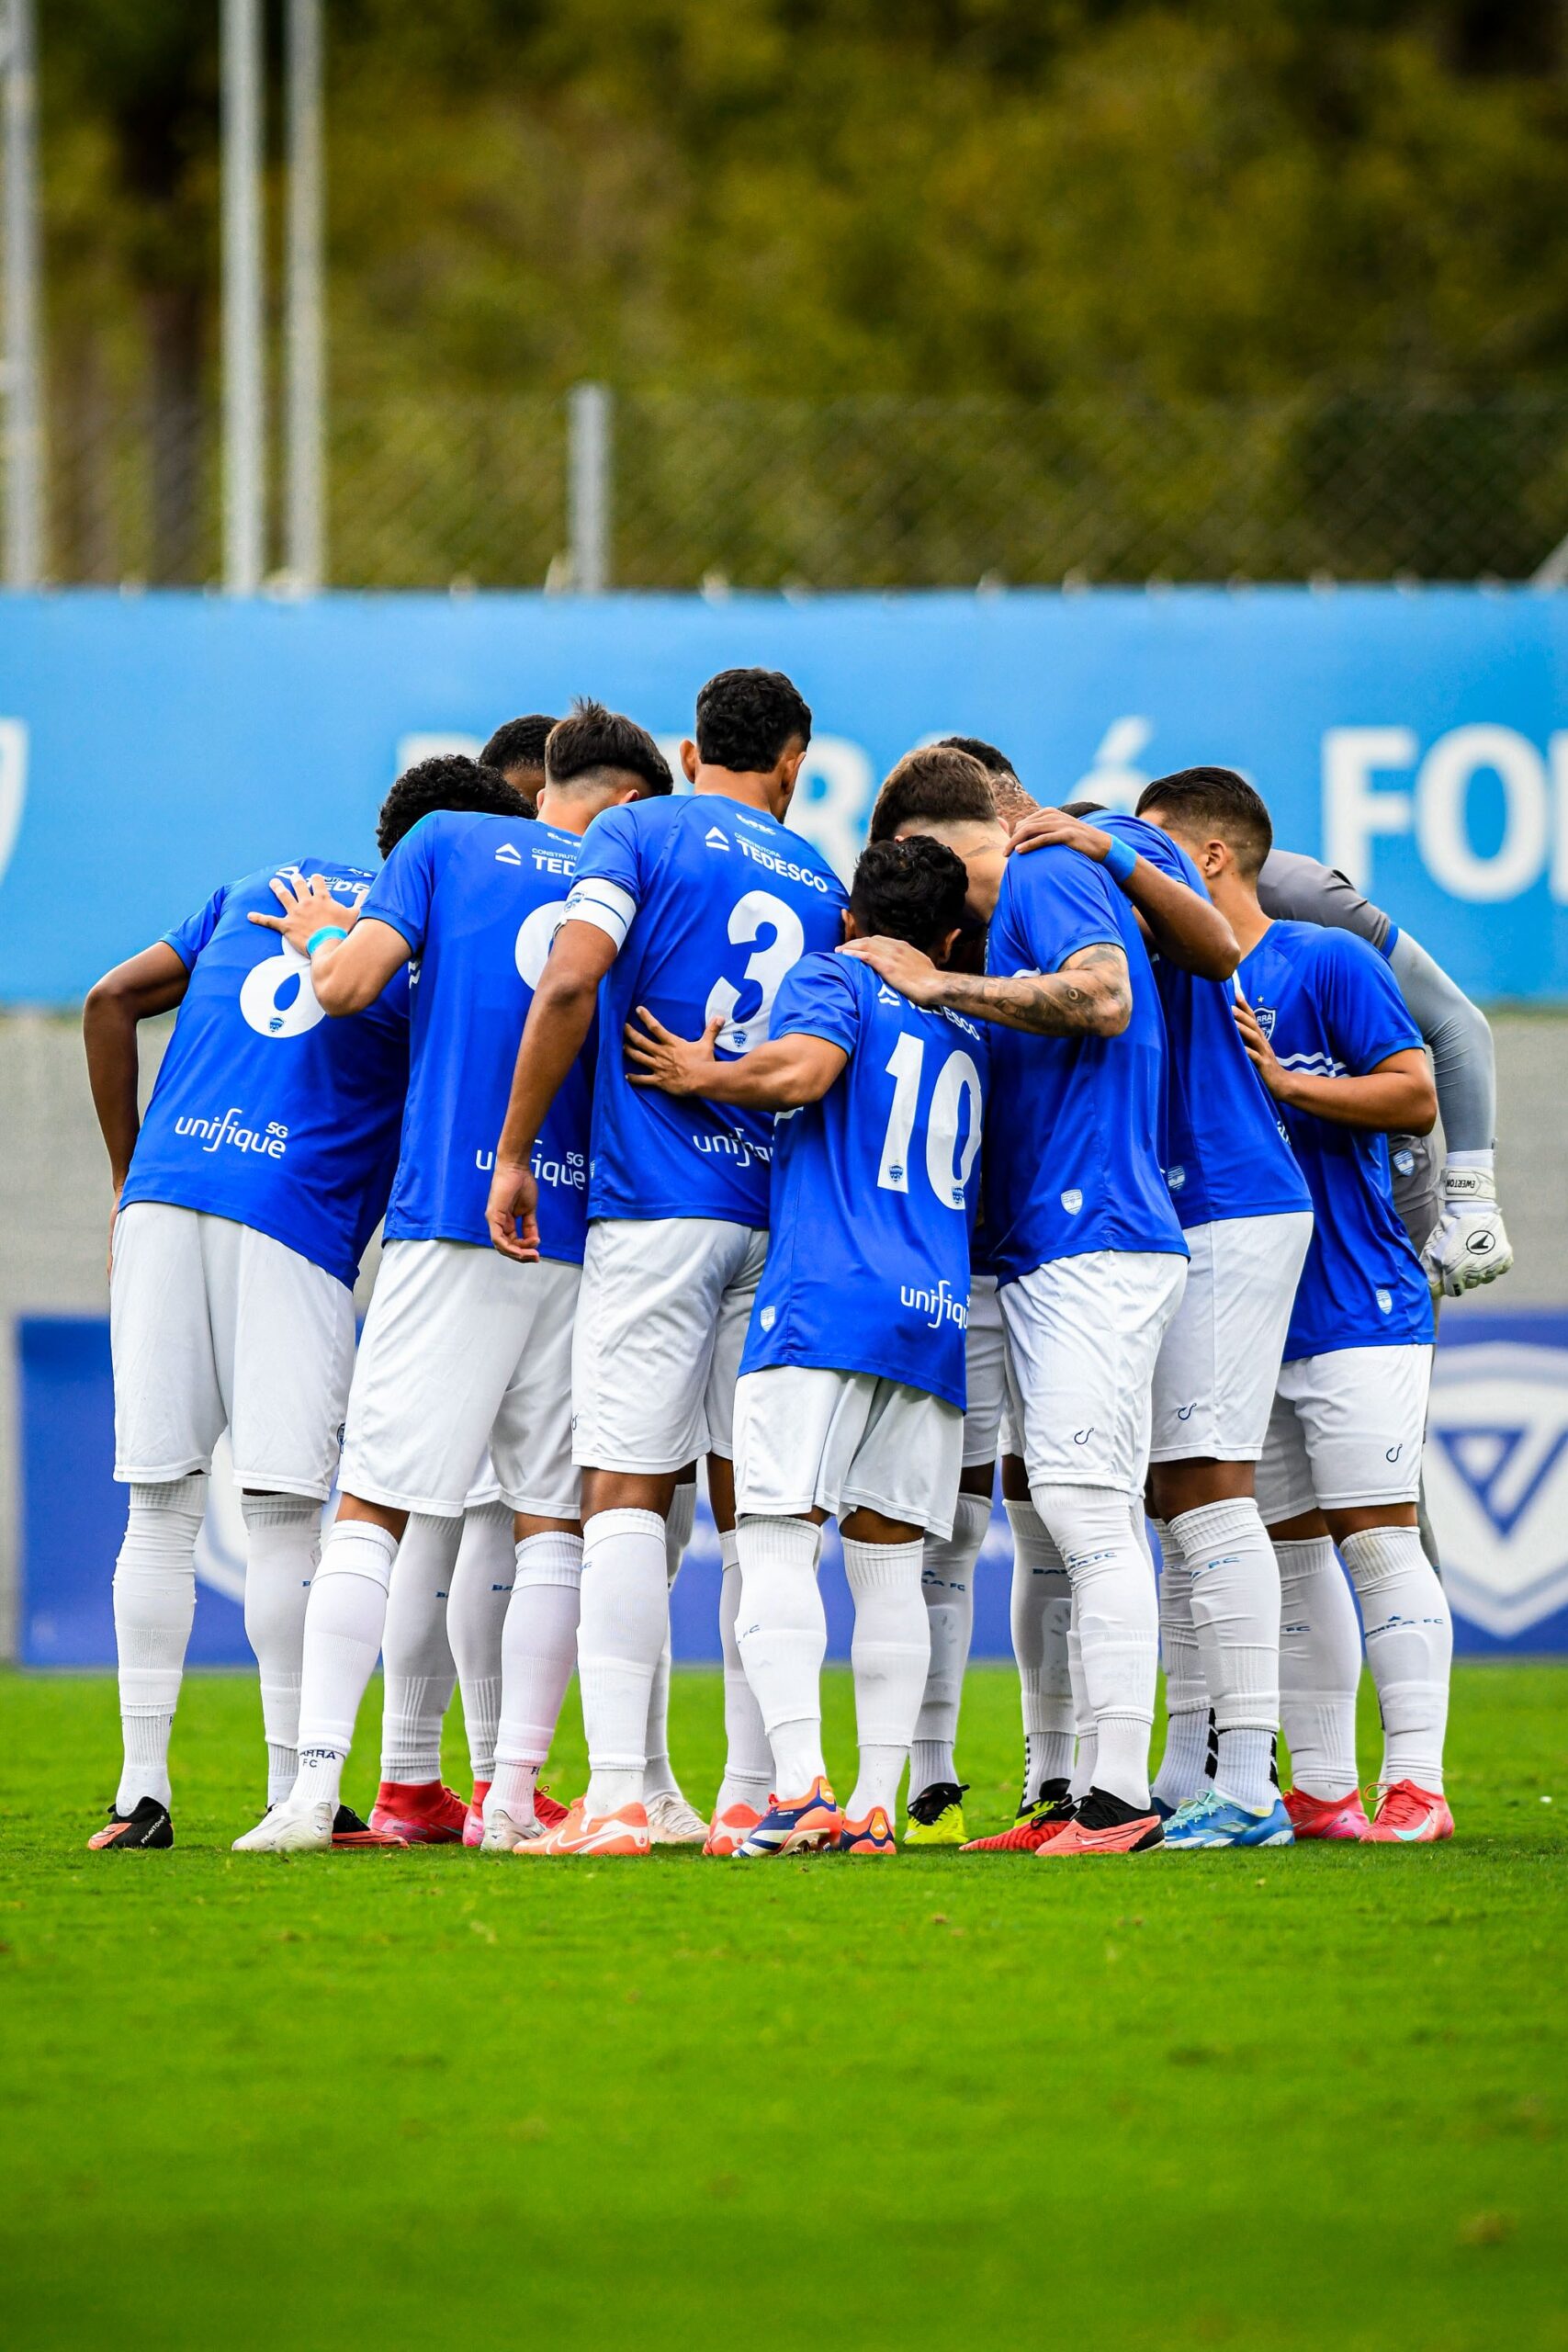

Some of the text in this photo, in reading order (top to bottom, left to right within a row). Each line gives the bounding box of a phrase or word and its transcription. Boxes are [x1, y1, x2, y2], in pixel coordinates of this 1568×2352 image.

[736, 839, 829, 894] TEDESCO
[1320, 723, 1568, 905] FO
[705, 889, 805, 1053] 3
[175, 1107, 288, 1159] unifique 5G
[475, 1138, 586, 1191] uique 5G
[876, 1031, 983, 1210] 10
